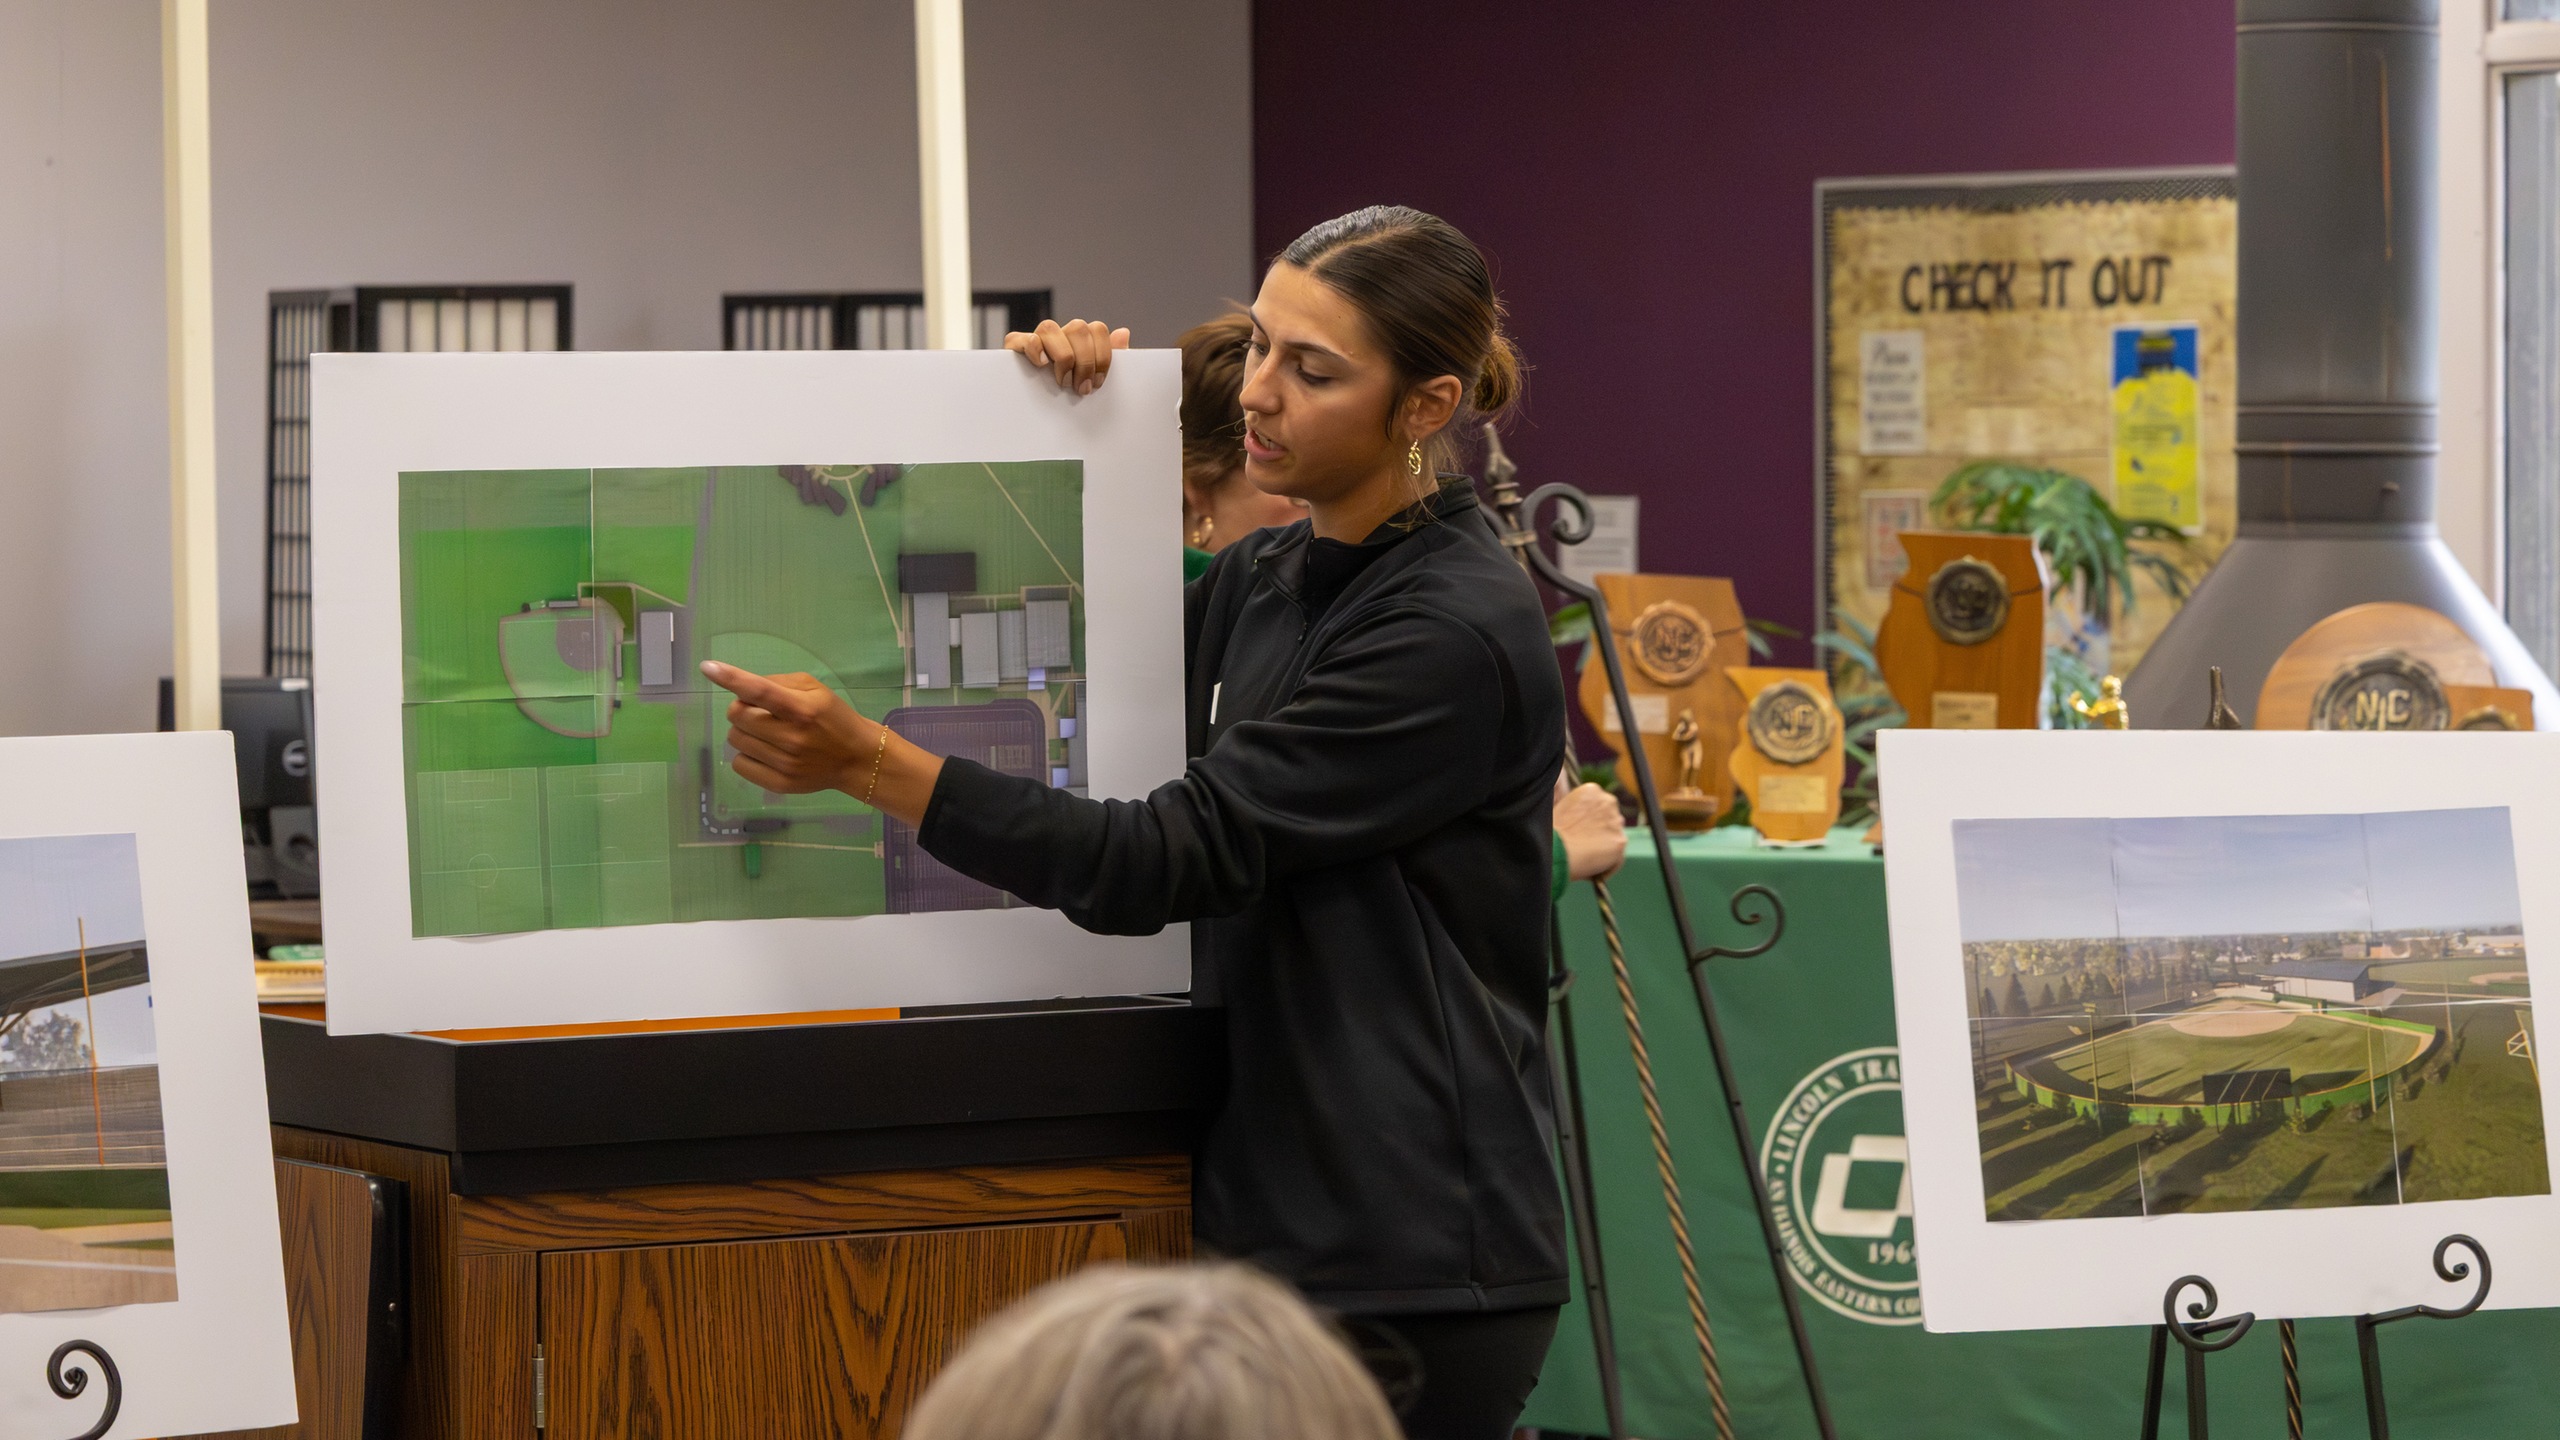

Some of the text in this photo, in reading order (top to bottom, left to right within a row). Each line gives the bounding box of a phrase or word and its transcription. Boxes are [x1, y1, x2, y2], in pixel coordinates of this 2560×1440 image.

[1901, 254, 2172, 314] CHECK IT OUT
[1772, 1072, 1846, 1162] LINCOLN
[1867, 1240, 1917, 1266] 196
